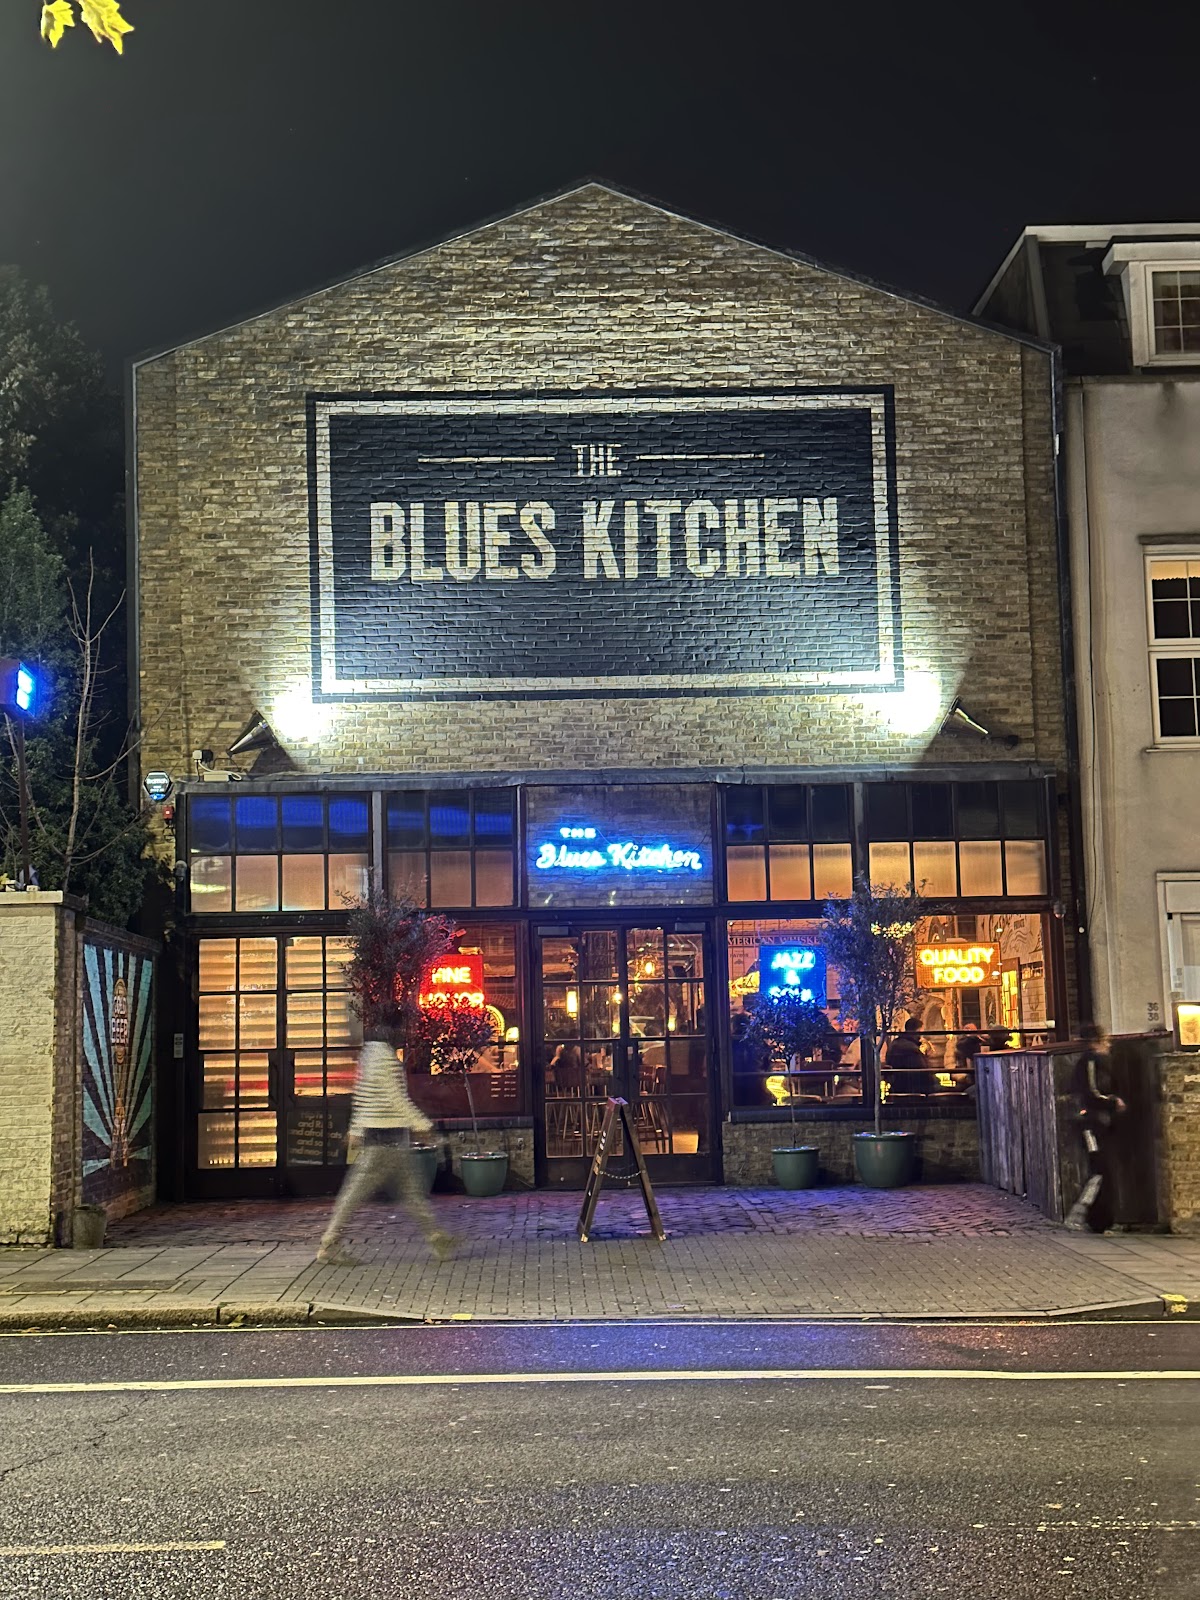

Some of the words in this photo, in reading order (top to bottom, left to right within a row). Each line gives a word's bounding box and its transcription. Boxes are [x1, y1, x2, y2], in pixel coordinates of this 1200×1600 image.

[571, 444, 622, 477] THE
[370, 501, 556, 582] BLUES
[582, 497, 840, 580] KITCHEN
[560, 827, 597, 839] THE
[536, 843, 607, 869] Blues
[607, 842, 702, 870] Kitchen
[728, 936, 775, 945] MERICAN
[771, 951, 816, 969] JAZZ
[920, 947, 994, 966] QUALITY
[431, 966, 472, 984] FINE
[932, 966, 985, 984] FOOD
[1147, 1002, 1159, 1011] 36
[1147, 1012, 1159, 1021] 38
[112, 1018, 129, 1043] BEER
